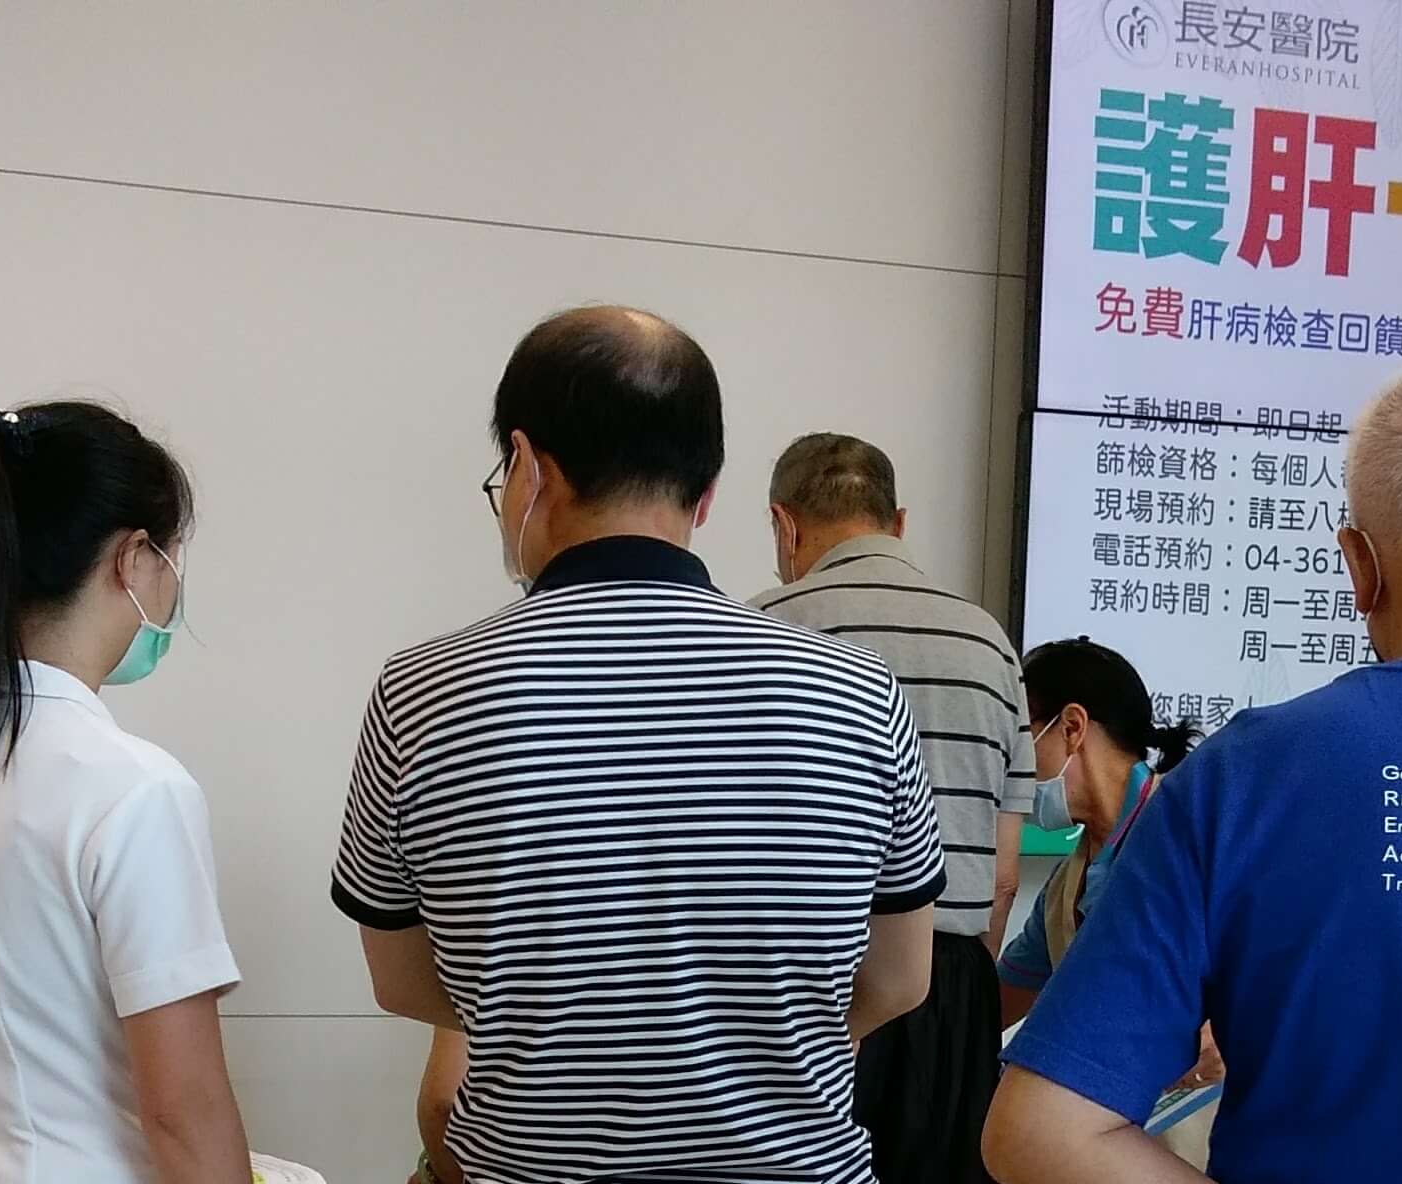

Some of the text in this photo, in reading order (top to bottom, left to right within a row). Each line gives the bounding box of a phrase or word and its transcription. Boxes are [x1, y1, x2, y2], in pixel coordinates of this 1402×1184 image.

[1174, 0, 1360, 65] 長安醫院
[1174, 52, 1361, 91] EVERANHOSPITAL
[1095, 441, 1349, 490] 篩檢資格：每個人
